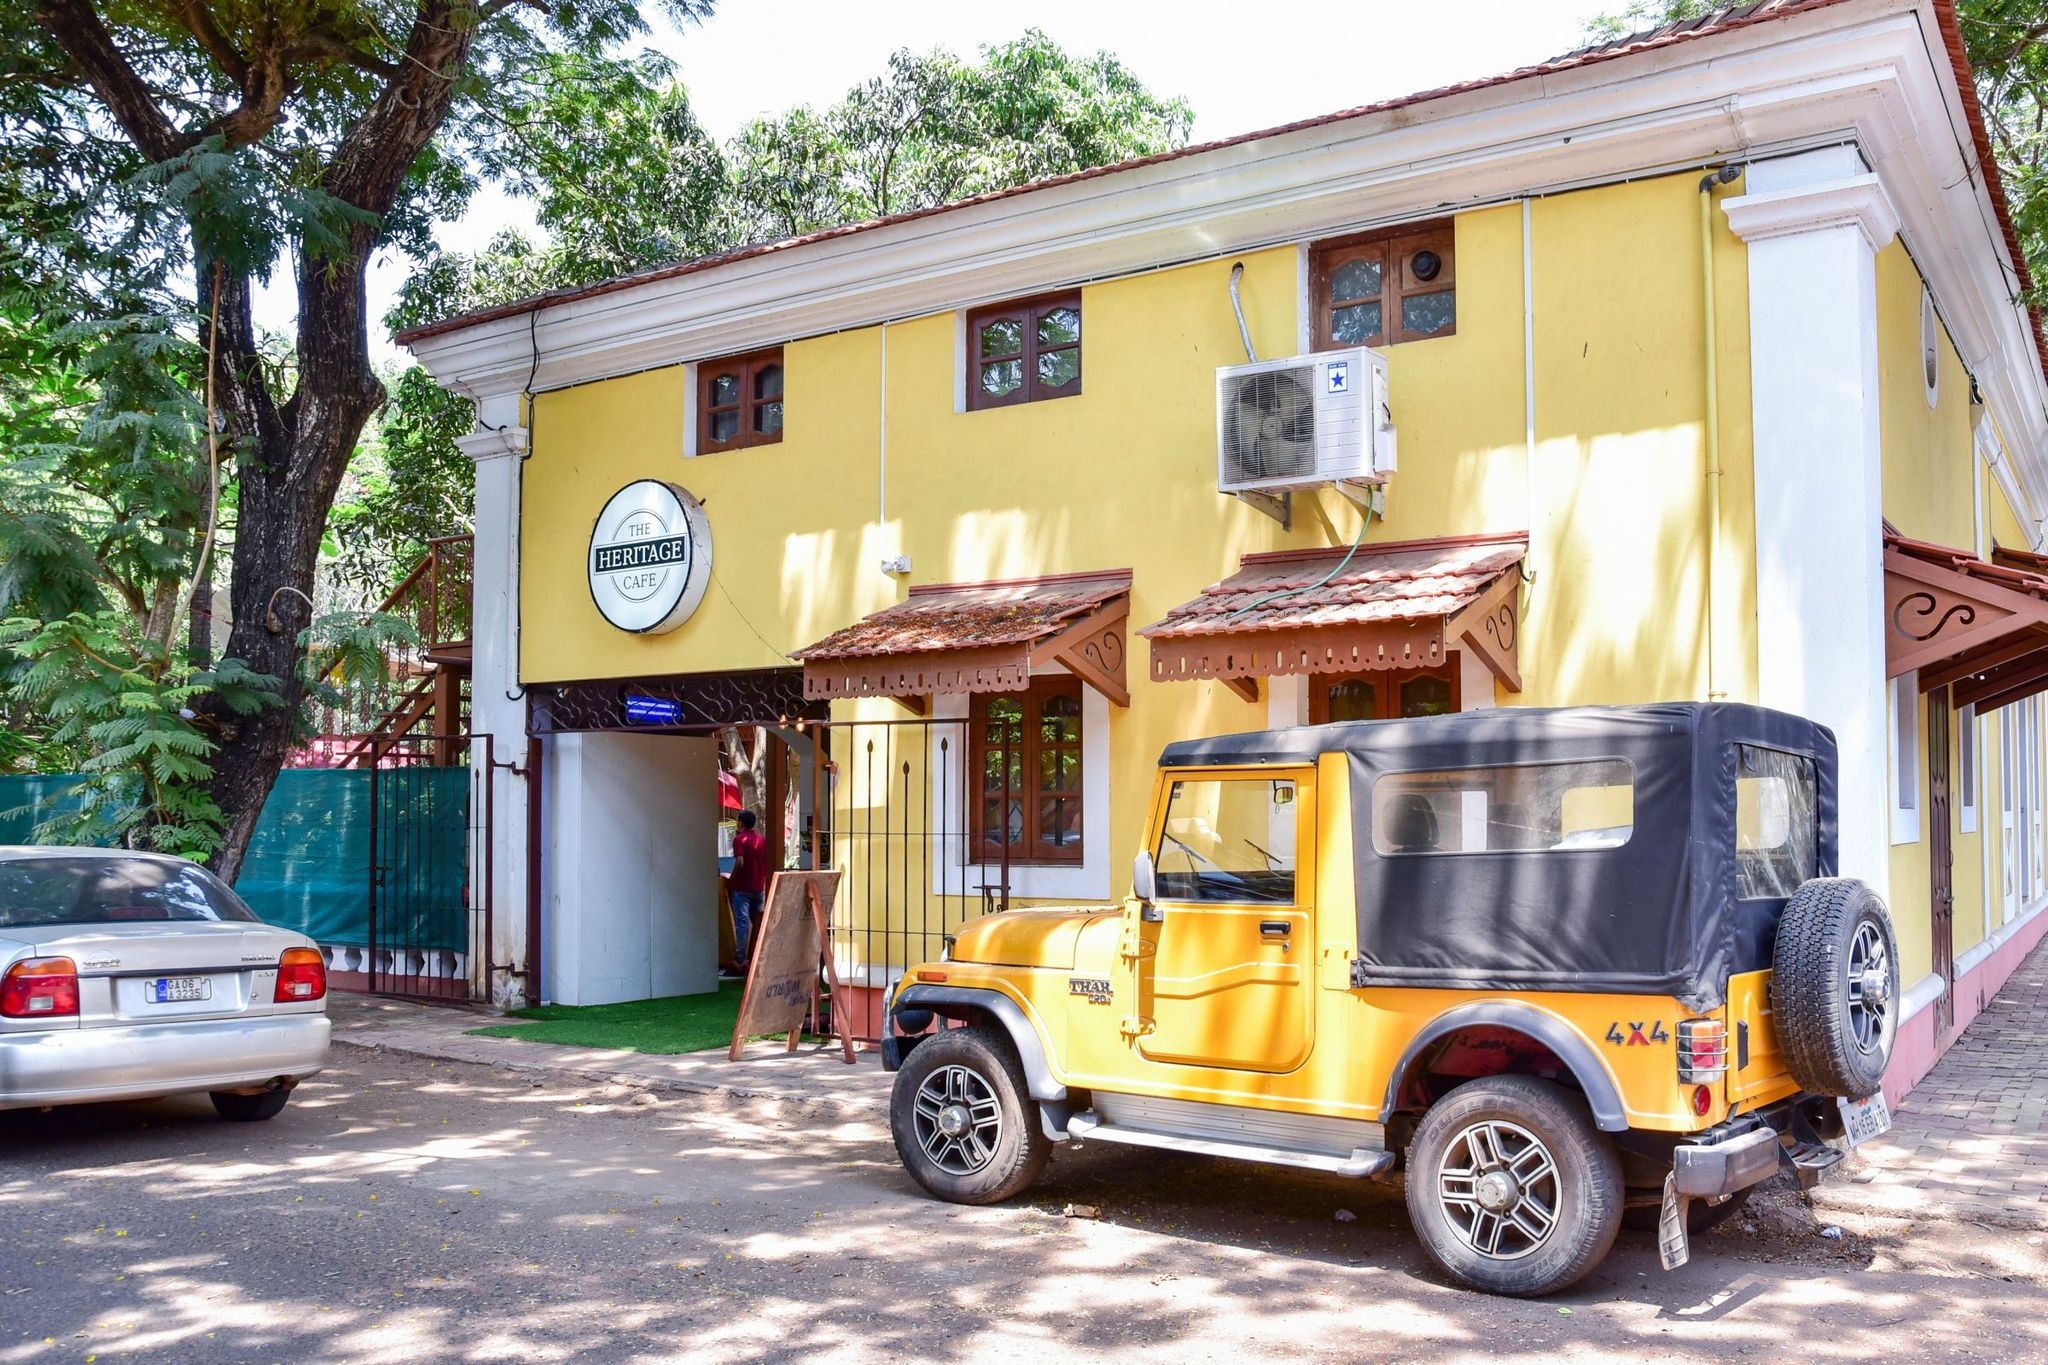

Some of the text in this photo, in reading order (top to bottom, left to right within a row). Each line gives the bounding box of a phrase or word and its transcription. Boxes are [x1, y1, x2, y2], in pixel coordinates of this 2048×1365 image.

[629, 522, 651, 537] THE
[599, 541, 682, 569] HERITAGE
[623, 572, 657, 590] CAFE
